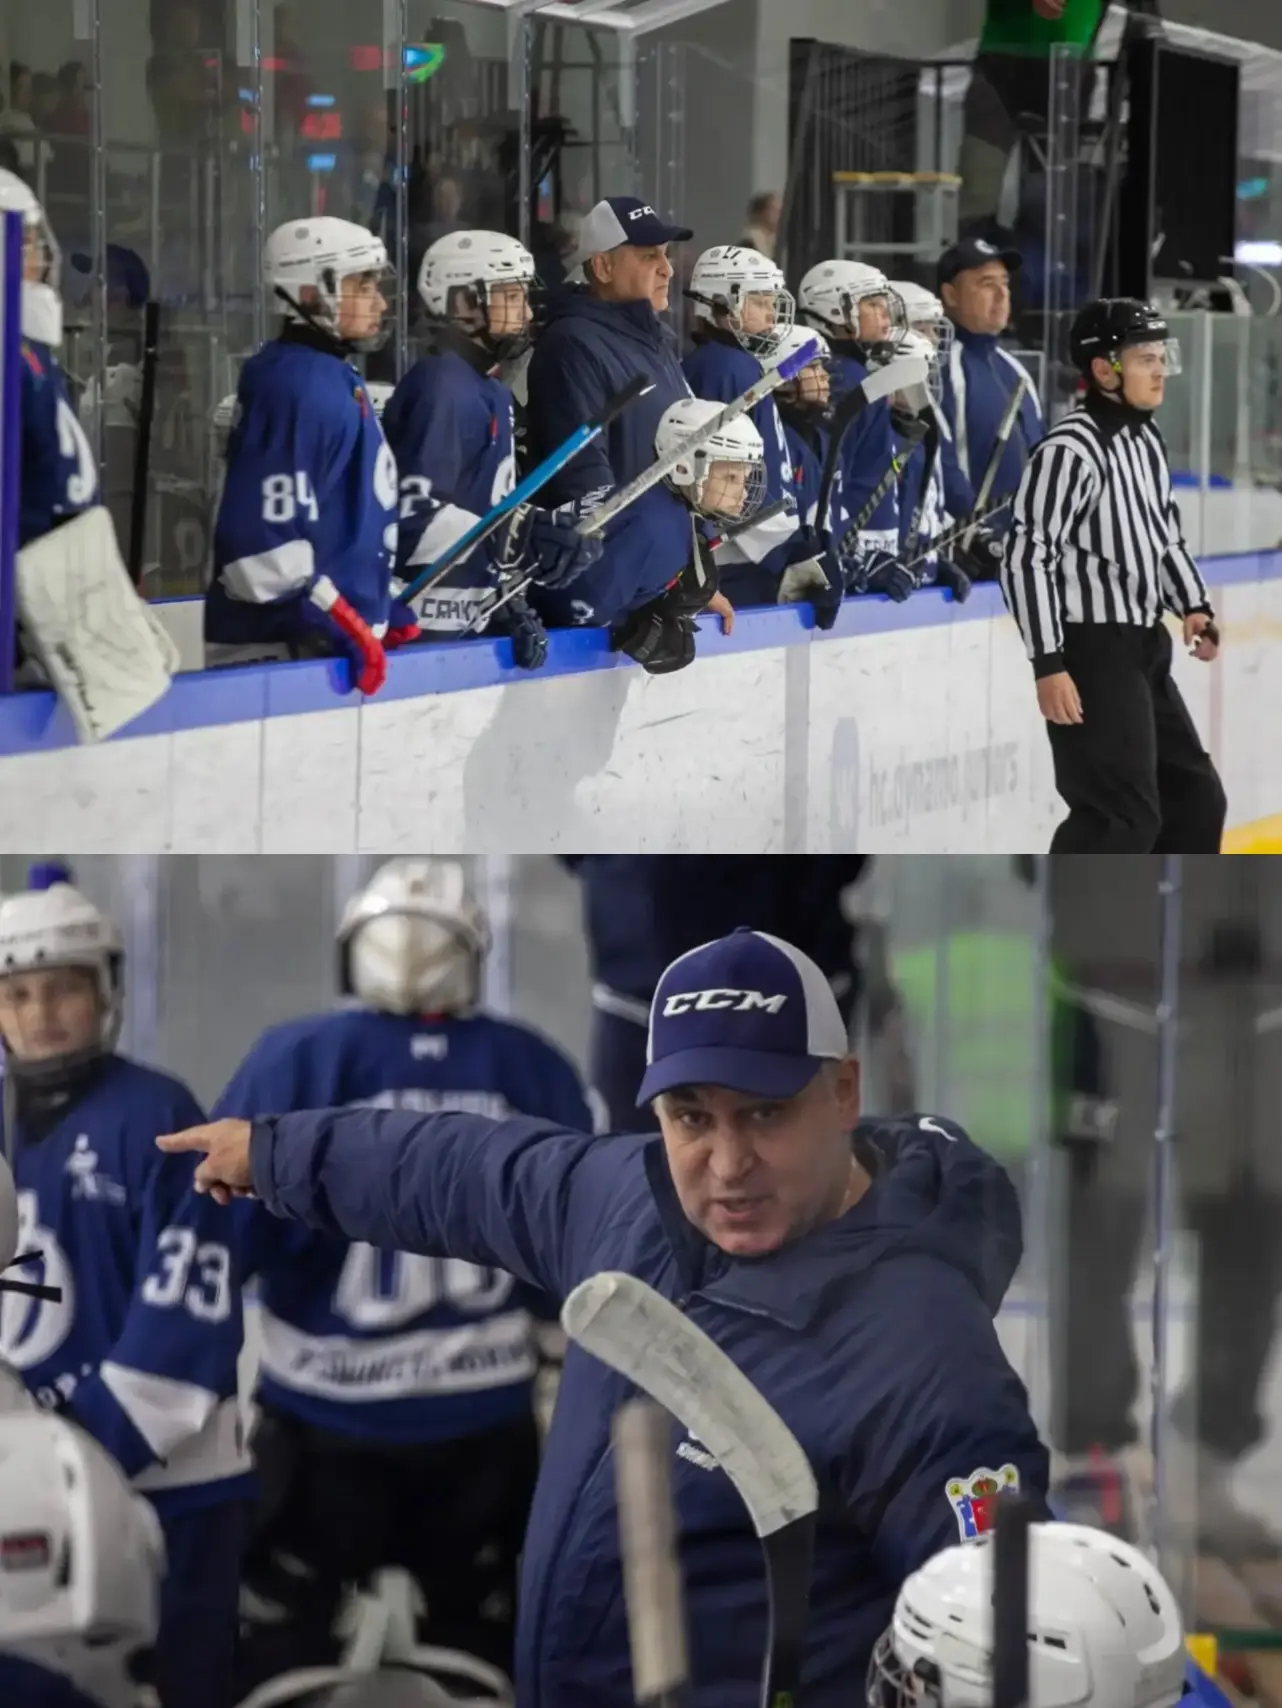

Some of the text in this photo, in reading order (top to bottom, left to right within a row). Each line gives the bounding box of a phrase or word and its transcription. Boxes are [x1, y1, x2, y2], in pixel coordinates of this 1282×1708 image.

[628, 205, 657, 220] CC
[262, 470, 319, 521] 84
[662, 988, 788, 1017] CCM
[142, 1227, 231, 1323] 33
